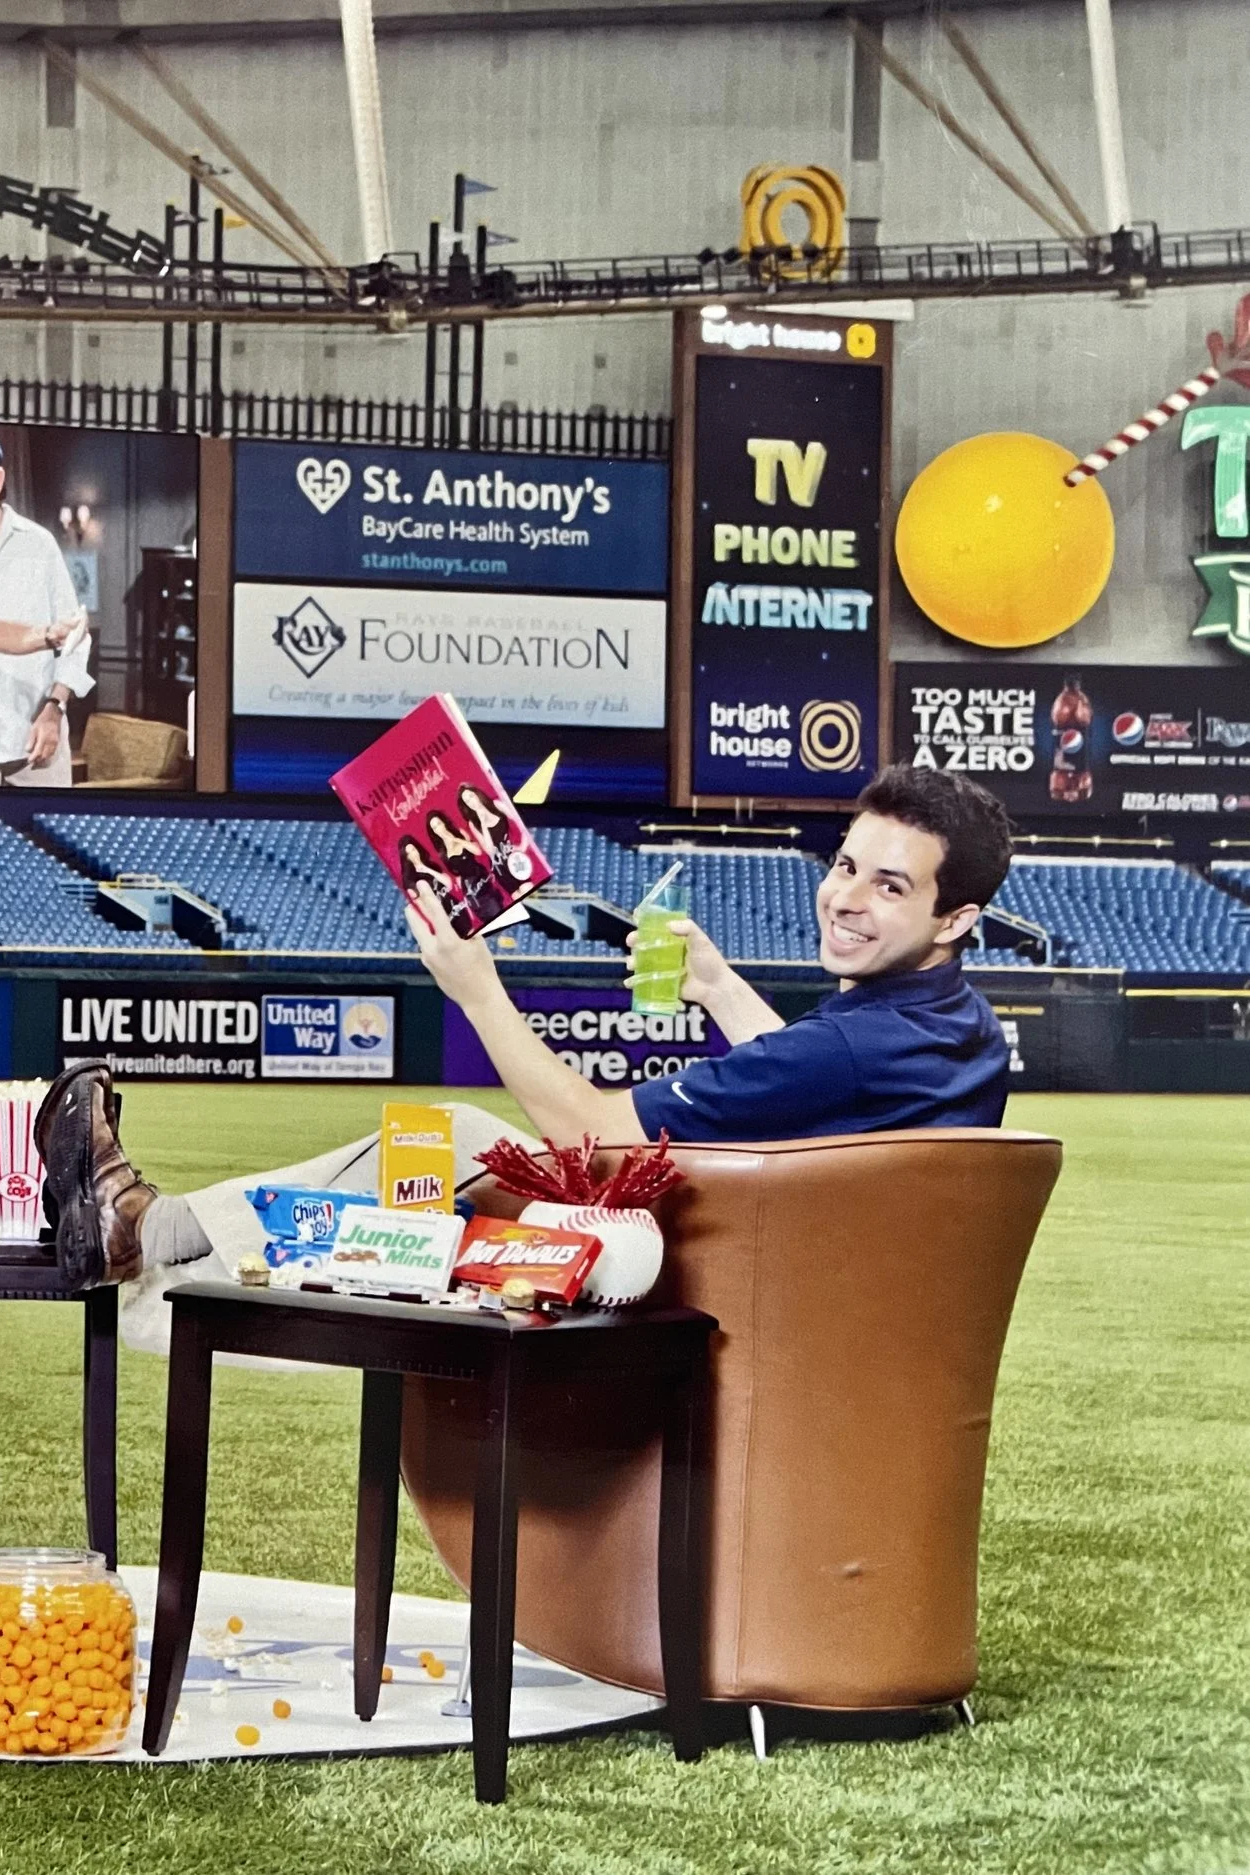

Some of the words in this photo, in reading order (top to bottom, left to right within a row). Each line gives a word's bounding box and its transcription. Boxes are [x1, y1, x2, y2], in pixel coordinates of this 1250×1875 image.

[747, 438, 828, 507] TV
[361, 465, 414, 505] St.
[422, 469, 613, 523] Anthony's
[361, 516, 445, 544] BayCare
[449, 520, 516, 544] Health
[519, 523, 590, 550] System
[713, 523, 860, 569] PHONE
[361, 551, 508, 576] stanthonys.com
[701, 581, 874, 632] INTERNET
[358, 618, 631, 671] FOUNDATION
[911, 687, 963, 707] TOO
[967, 688, 1036, 707] MUCH
[710, 701, 791, 734] bright
[911, 705, 1035, 735] TASTE
[710, 730, 792, 759] house
[912, 744, 938, 770] A
[944, 744, 1035, 772] ZERO
[62, 998, 133, 1042] LIVE
[141, 999, 259, 1045] UNITED
[266, 1002, 336, 1026] United
[293, 1025, 337, 1055] Way
[396, 1176, 441, 1203] Milk
[292, 1203, 327, 1224] Chips
[338, 1223, 435, 1252] Junior
[384, 1250, 444, 1270] Mints
[455, 1239, 505, 1269] HOT
[494, 1240, 583, 1267] TAMALES
